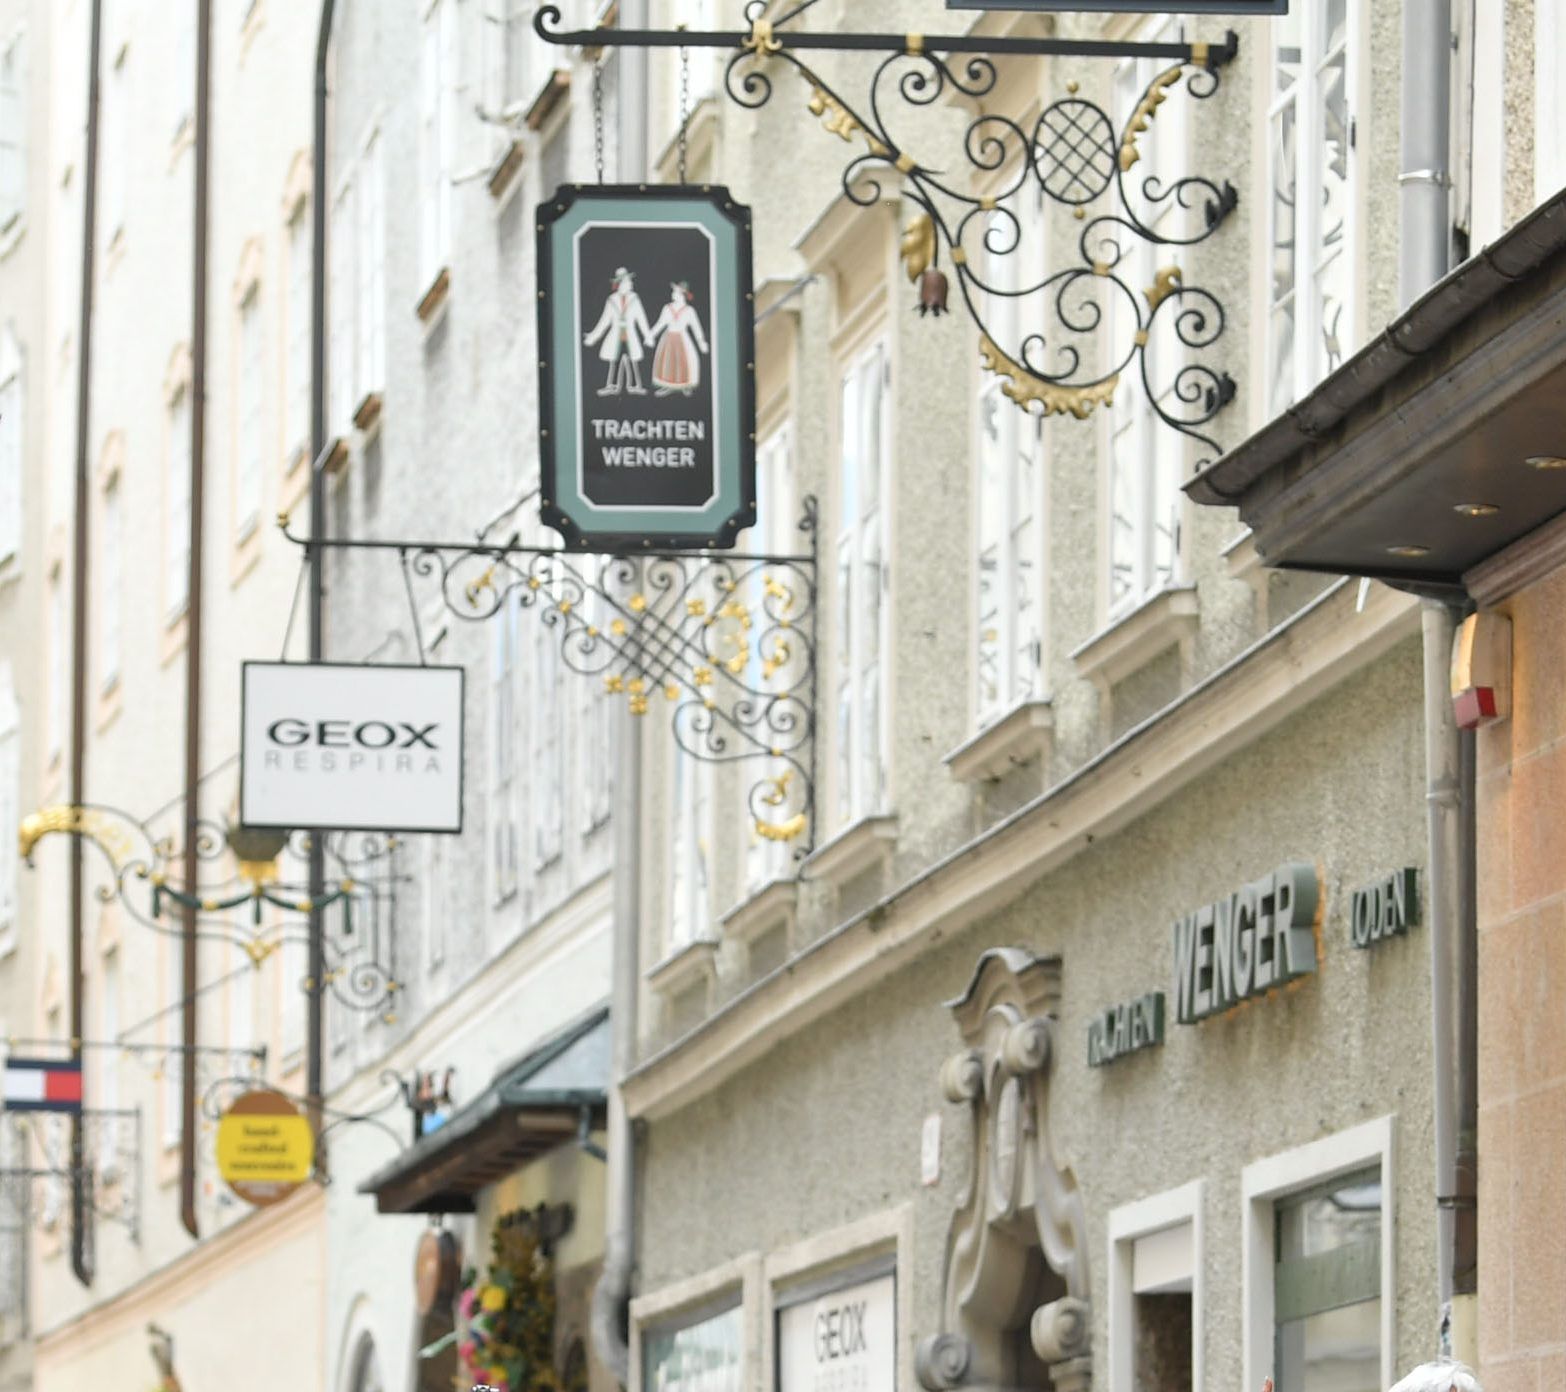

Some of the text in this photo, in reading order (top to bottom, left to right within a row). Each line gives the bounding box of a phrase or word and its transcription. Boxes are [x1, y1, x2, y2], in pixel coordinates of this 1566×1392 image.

[591, 419, 705, 440] TRACHTEN
[602, 447, 696, 468] WENGER
[267, 717, 440, 750] GEOX
[264, 750, 442, 774] RESPIRA
[1172, 862, 1317, 1025] WENGER
[814, 1300, 867, 1363] GEOX
